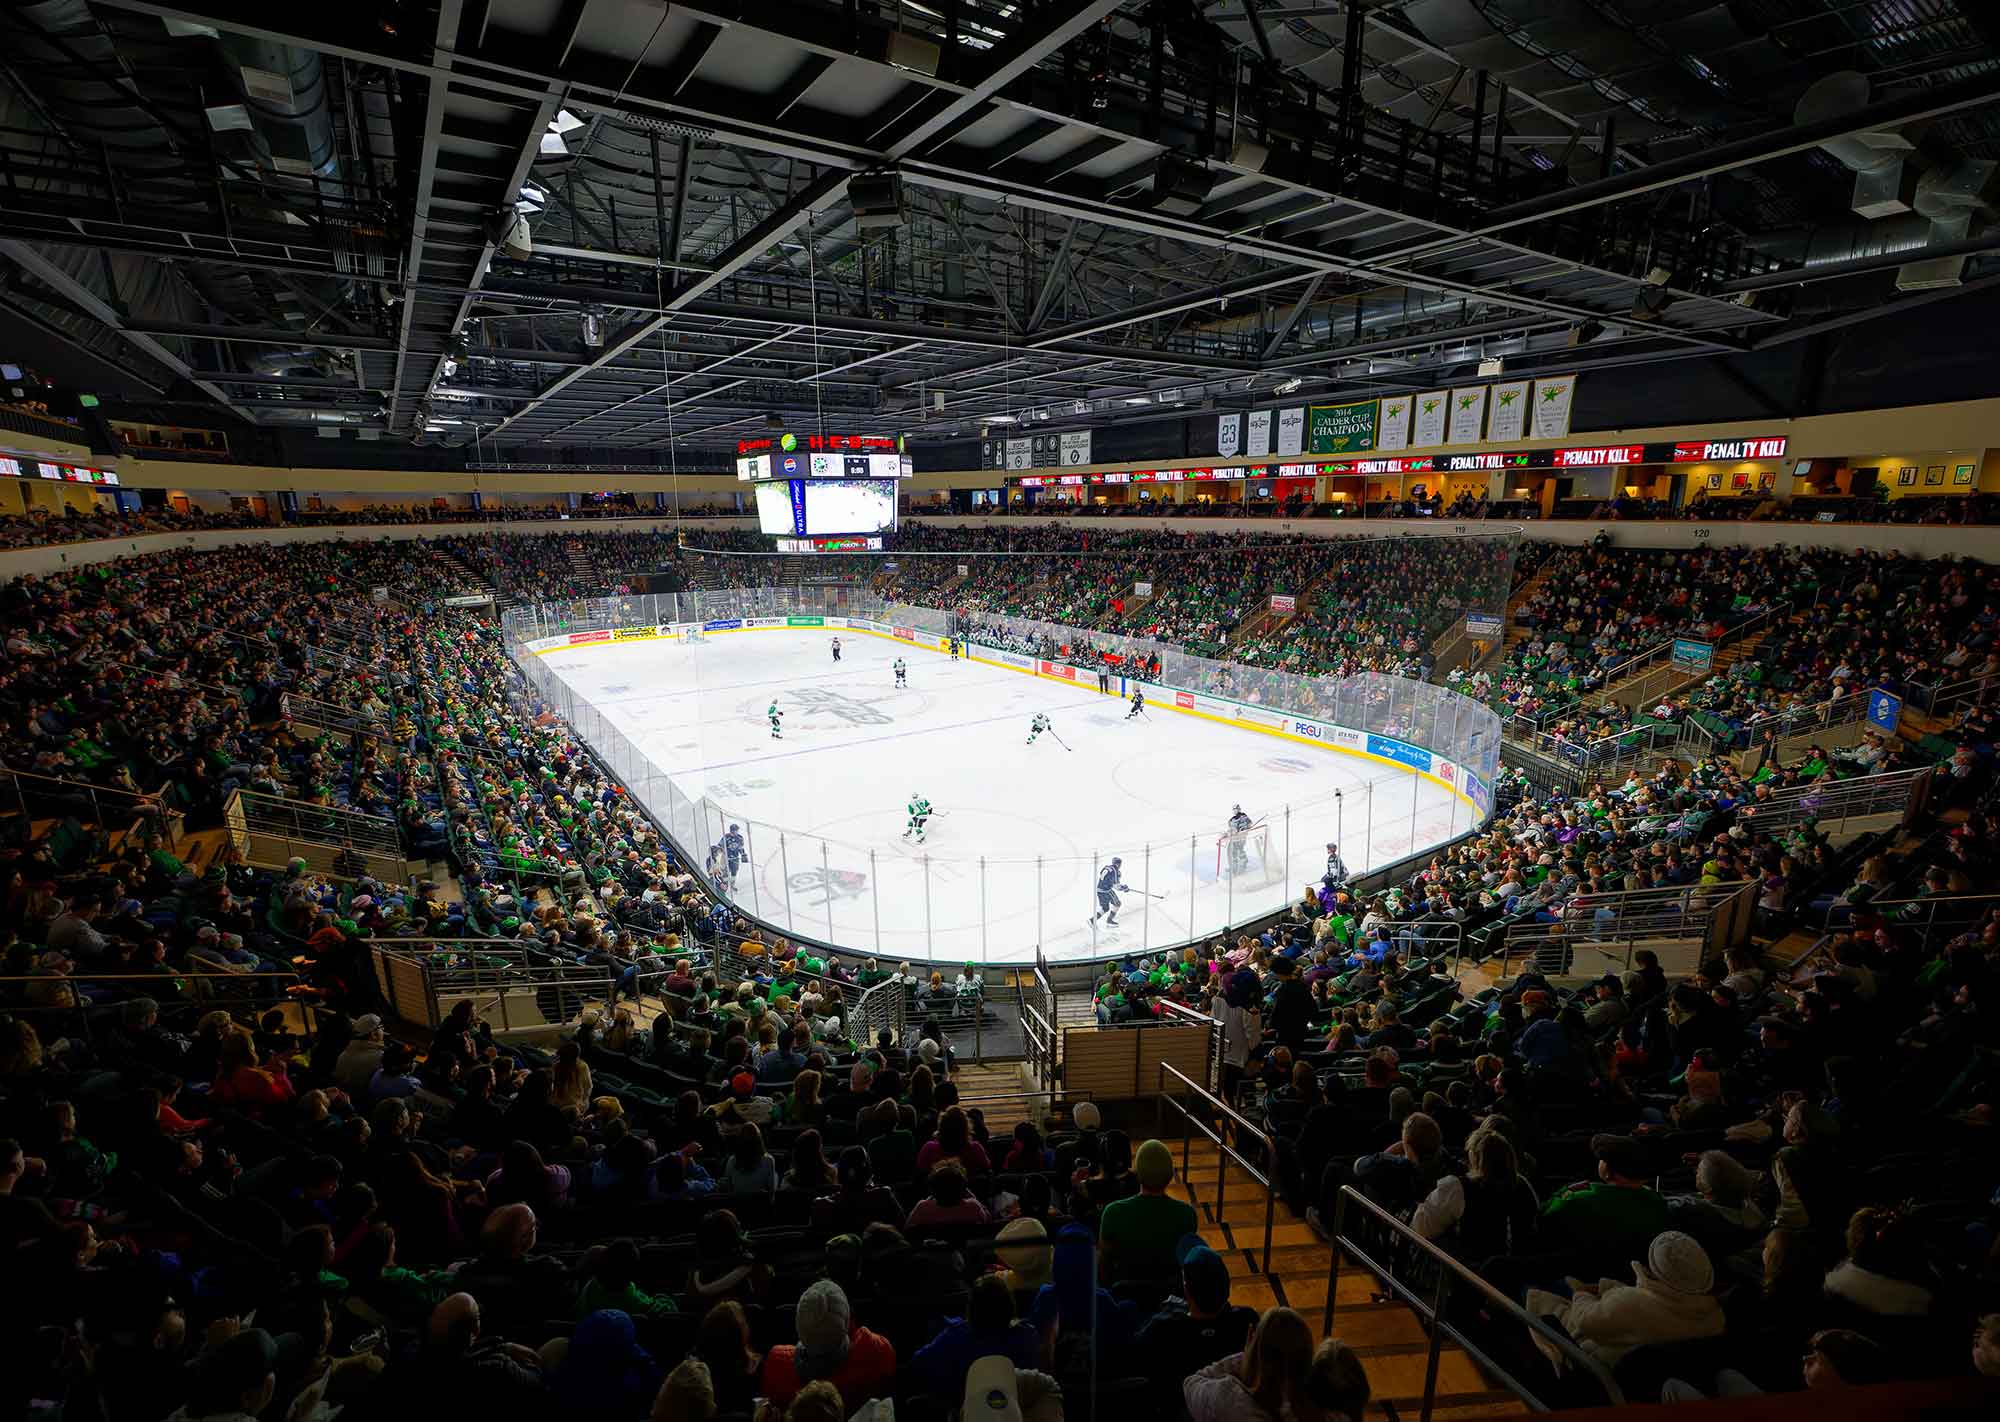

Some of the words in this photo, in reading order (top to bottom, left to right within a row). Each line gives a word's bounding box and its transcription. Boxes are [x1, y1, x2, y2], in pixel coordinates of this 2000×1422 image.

[1317, 416, 1350, 426] CALDER
[1351, 413, 1370, 424] CUP
[1335, 408, 1352, 418] 2014
[1221, 424, 1237, 444] 23
[1313, 421, 1373, 436] CHAMPIONS
[1563, 449, 1606, 465] PENALTY
[1608, 448, 1630, 463] KILL
[1703, 442, 1758, 459] PENALTY
[1279, 465, 1304, 476] PENALTY
[1305, 464, 1317, 475] KILL
[1357, 462, 1387, 473] PENALTY
[1388, 460, 1403, 472] KILL
[1450, 456, 1485, 470] PENALTY
[1487, 455, 1504, 468] KILL
[796, 509, 804, 533] ULTRA
[1694, 528, 1710, 538] 120
